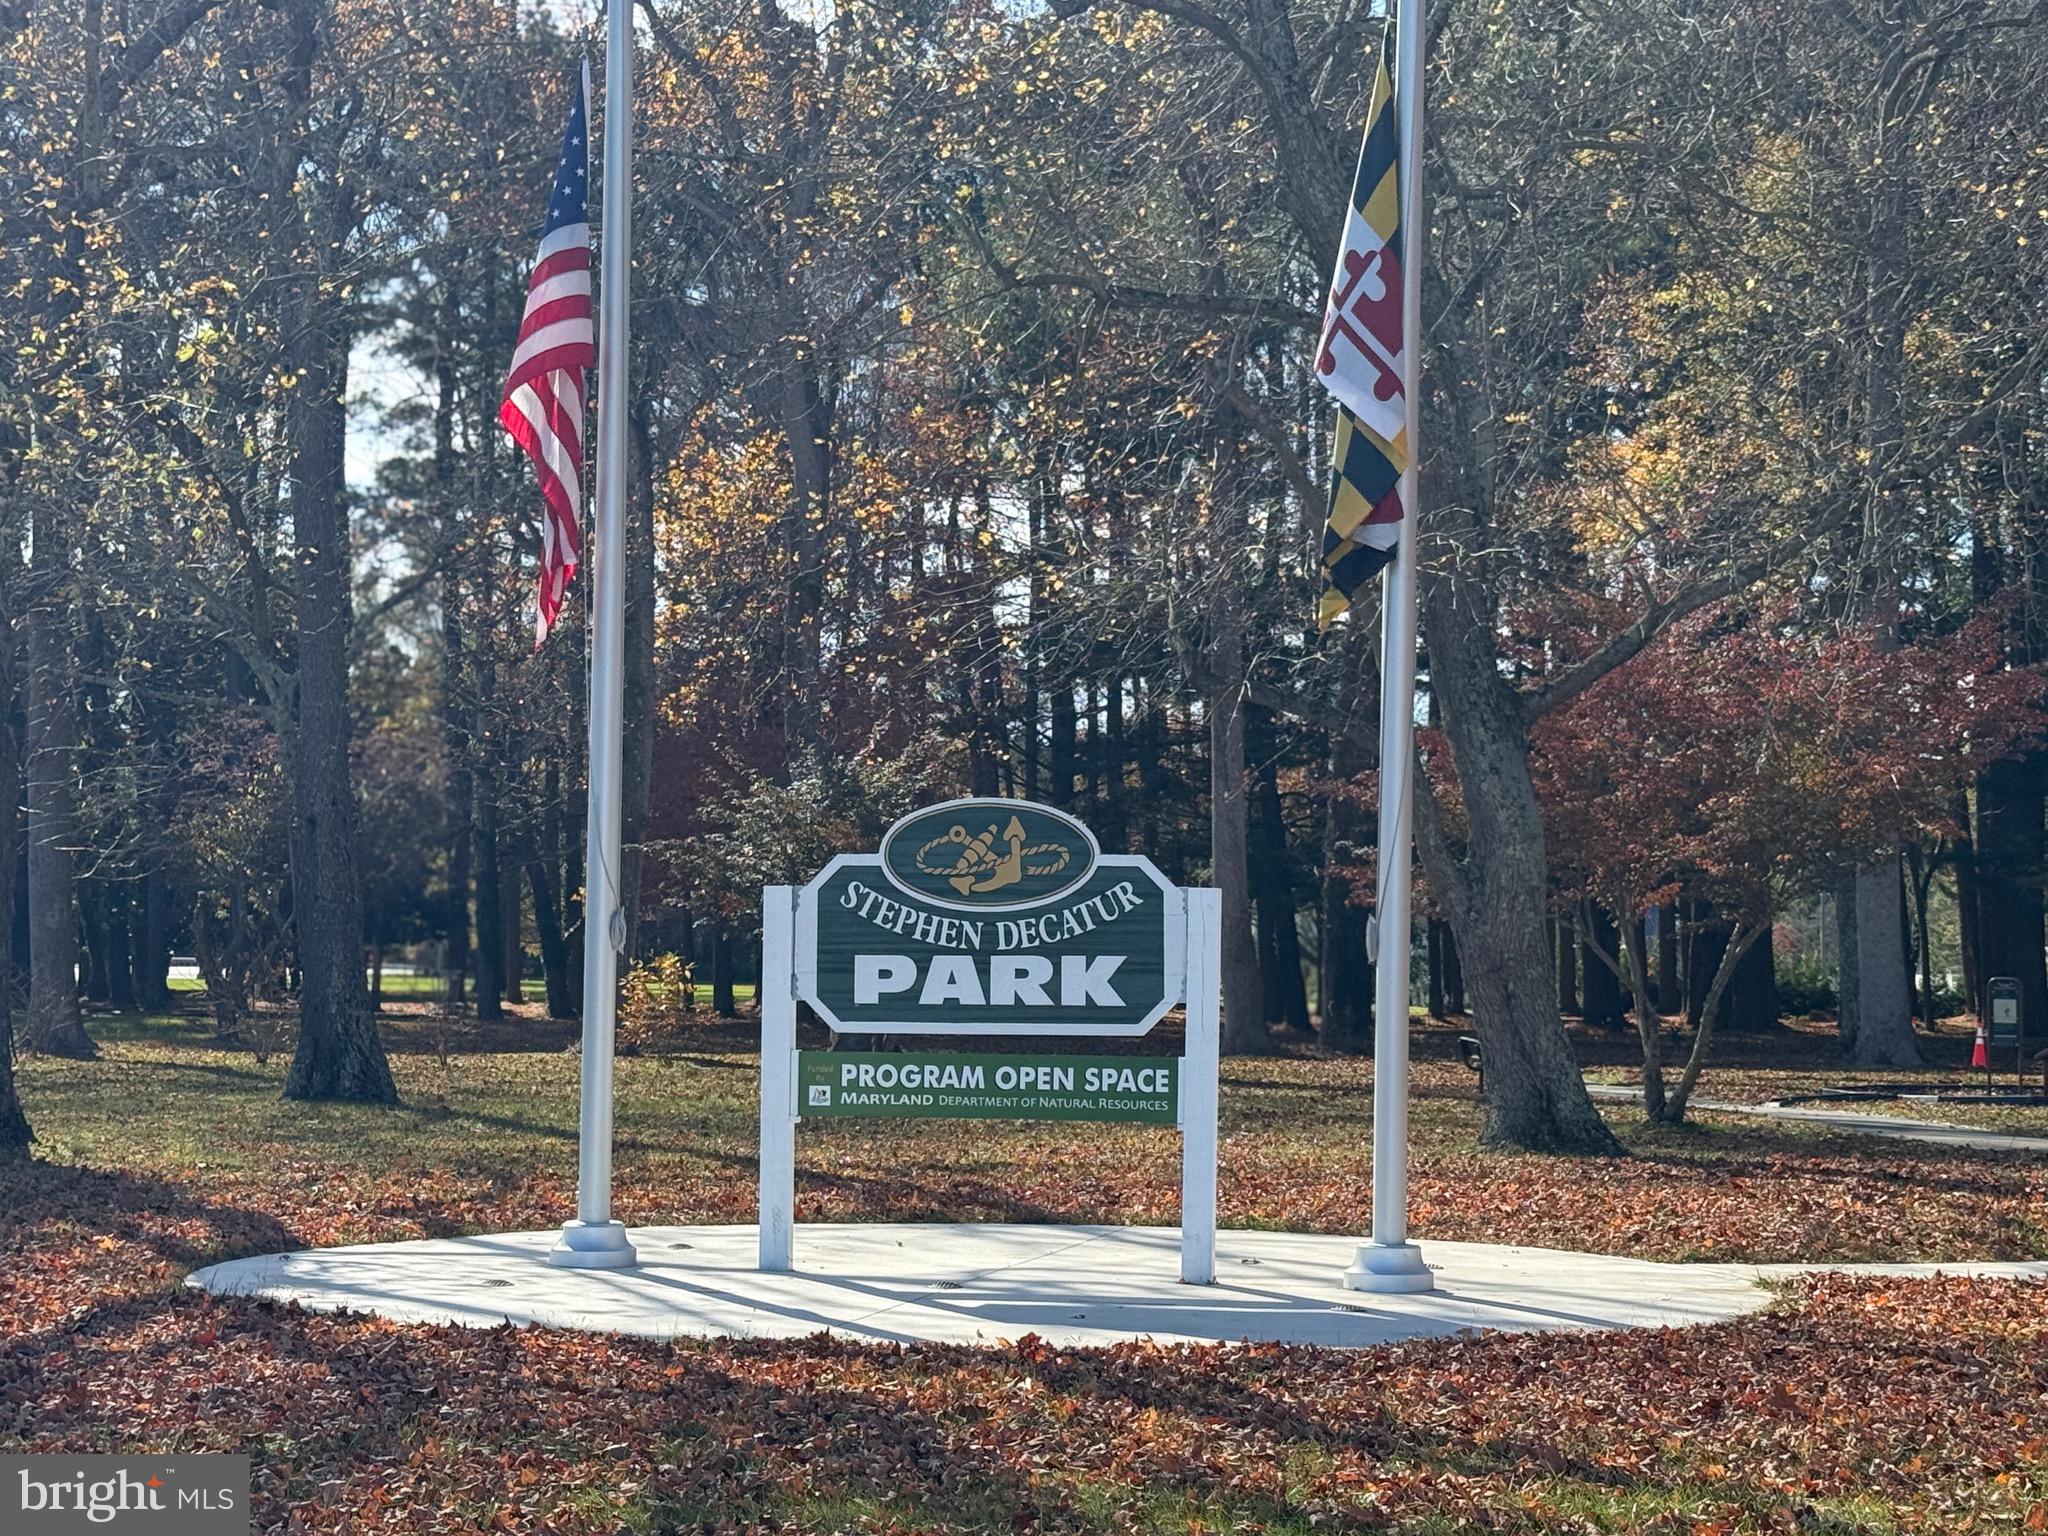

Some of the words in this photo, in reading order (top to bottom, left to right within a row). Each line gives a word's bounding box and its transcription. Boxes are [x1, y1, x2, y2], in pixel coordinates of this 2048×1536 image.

[840, 881, 984, 951] STEPHEN
[996, 881, 1144, 951] DECATUR
[854, 954, 1128, 1007] PARK
[841, 1063, 985, 1089] PROGRAM
[995, 1066, 1074, 1091] OPEN
[1084, 1068, 1170, 1093] SPACE
[840, 1092, 934, 1106] MARYLAND
[939, 1096, 1019, 1107] DEPARTMENT
[1021, 1097, 1037, 1107] OF
[1039, 1097, 1096, 1109] NATURAL
[1099, 1099, 1169, 1110] RESOURCES
